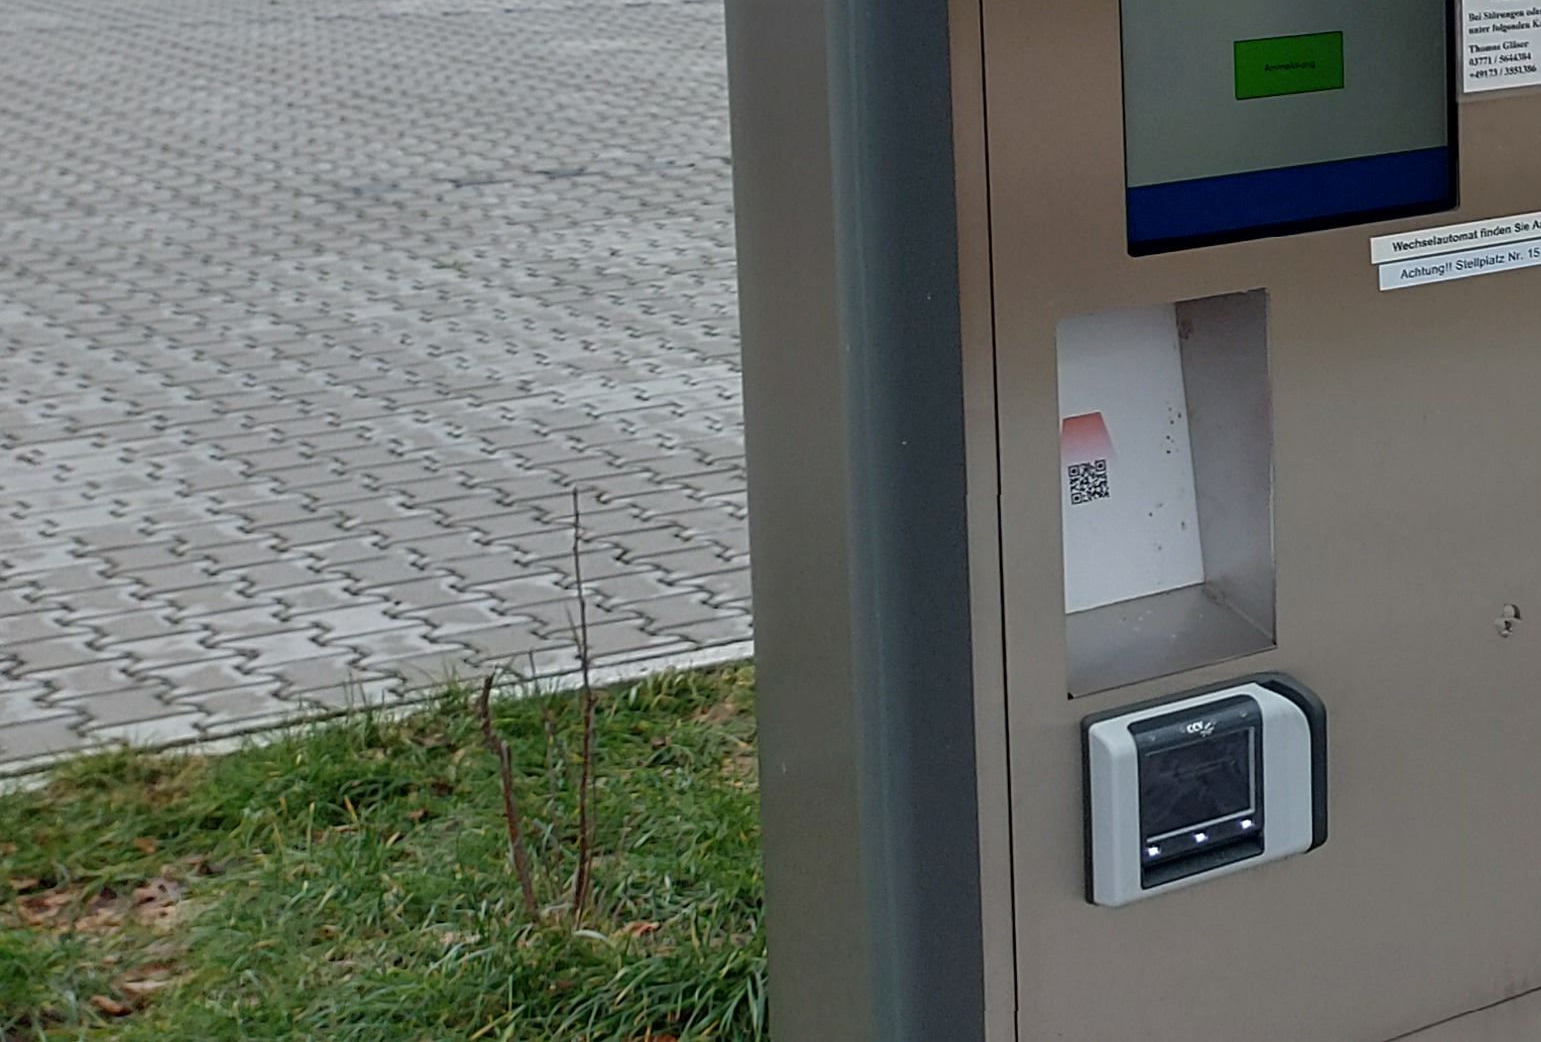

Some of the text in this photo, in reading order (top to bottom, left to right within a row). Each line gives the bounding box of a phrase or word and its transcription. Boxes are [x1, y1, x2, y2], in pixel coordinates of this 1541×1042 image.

[1392, 230, 1478, 252] Wechselautomat
[1480, 224, 1511, 238] finden
[1515, 221, 1529, 234] Sie
[1400, 262, 1452, 280] Achtung!!
[1456, 253, 1505, 271] Stellplatz
[1508, 252, 1523, 262] Nr.
[1528, 249, 1540, 258] 15
